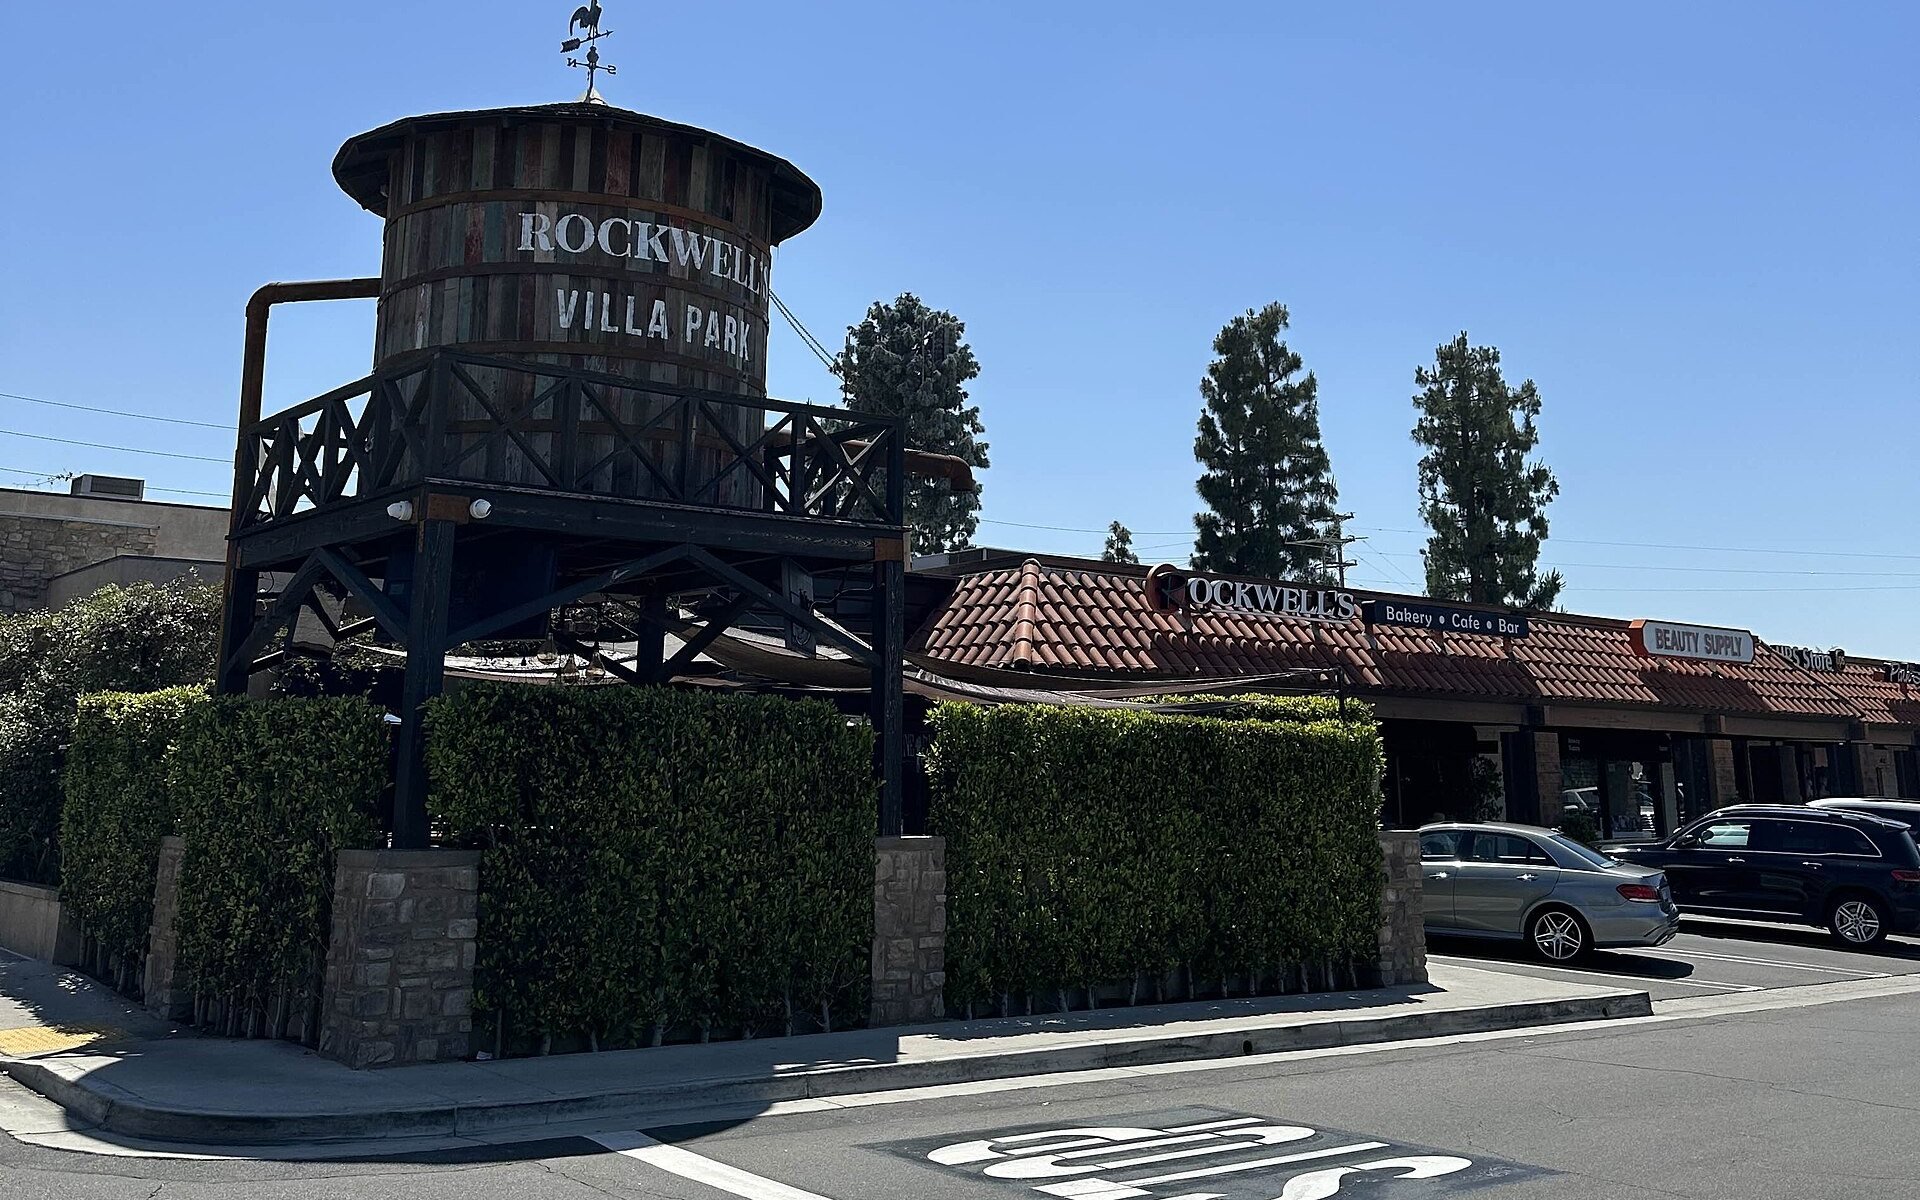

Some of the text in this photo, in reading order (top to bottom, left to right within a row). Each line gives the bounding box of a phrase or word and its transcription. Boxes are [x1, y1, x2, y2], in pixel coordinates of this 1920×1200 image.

[557, 288, 751, 361] VILLA PARK
[1386, 606, 1520, 635] Bakery Cafe Bar
[1655, 628, 1743, 657] BEAUTY SUPPLY
[1802, 648, 1834, 672] Store
